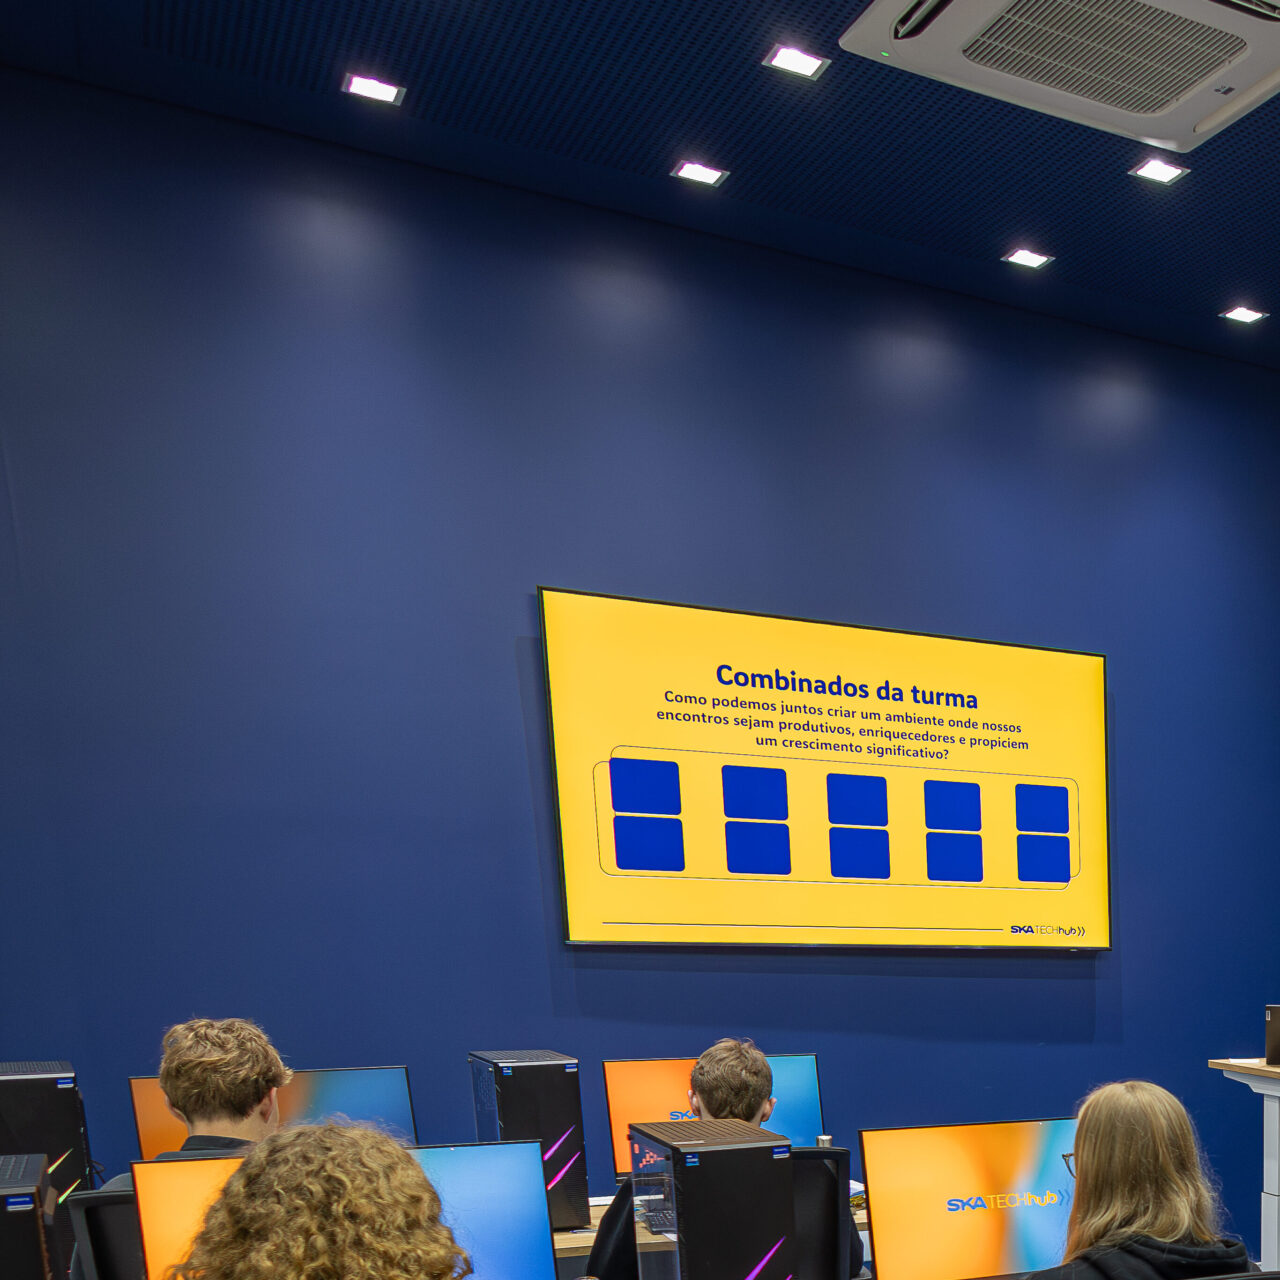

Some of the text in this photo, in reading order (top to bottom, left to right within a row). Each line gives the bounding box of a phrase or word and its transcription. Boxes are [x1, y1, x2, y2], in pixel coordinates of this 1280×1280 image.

[717, 665, 977, 709] Combinados da turma
[657, 711, 1029, 751] encontros sejam produtivos, enriquecedores e propiciem
[665, 690, 1022, 734] Como podemos juntos criar um ambiente onde nossos
[756, 736, 949, 760] um crescimento significativo?
